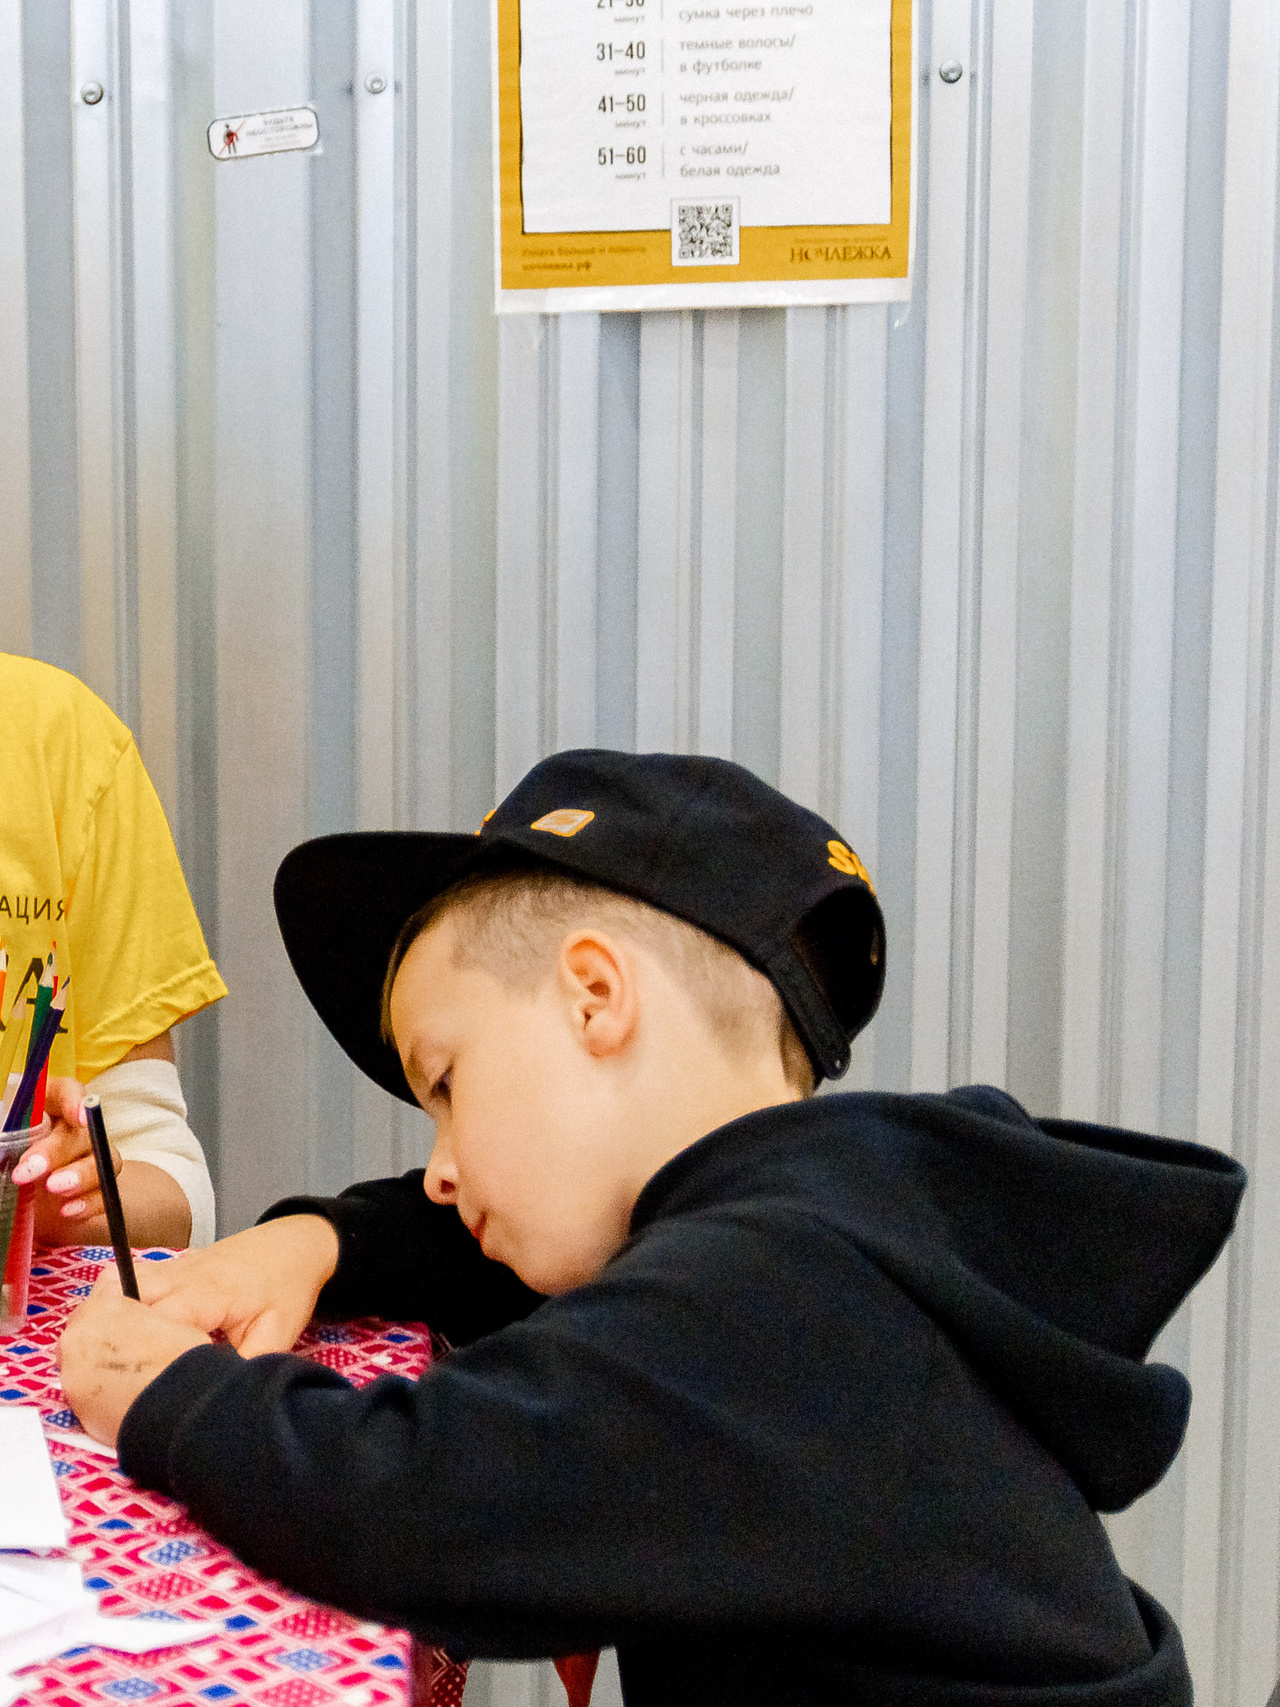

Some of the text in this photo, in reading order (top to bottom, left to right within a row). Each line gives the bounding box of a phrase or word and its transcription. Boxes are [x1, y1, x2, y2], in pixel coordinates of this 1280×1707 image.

[679, 5, 813, 23] сумка через плечо
[679, 34, 797, 50] темные волосы/
[680, 58, 762, 76] в футболке
[679, 86, 795, 106] черная одежда/
[680, 111, 771, 127] в кроссовках
[692, 140, 749, 156] часами/
[680, 163, 781, 178] белая одежда
